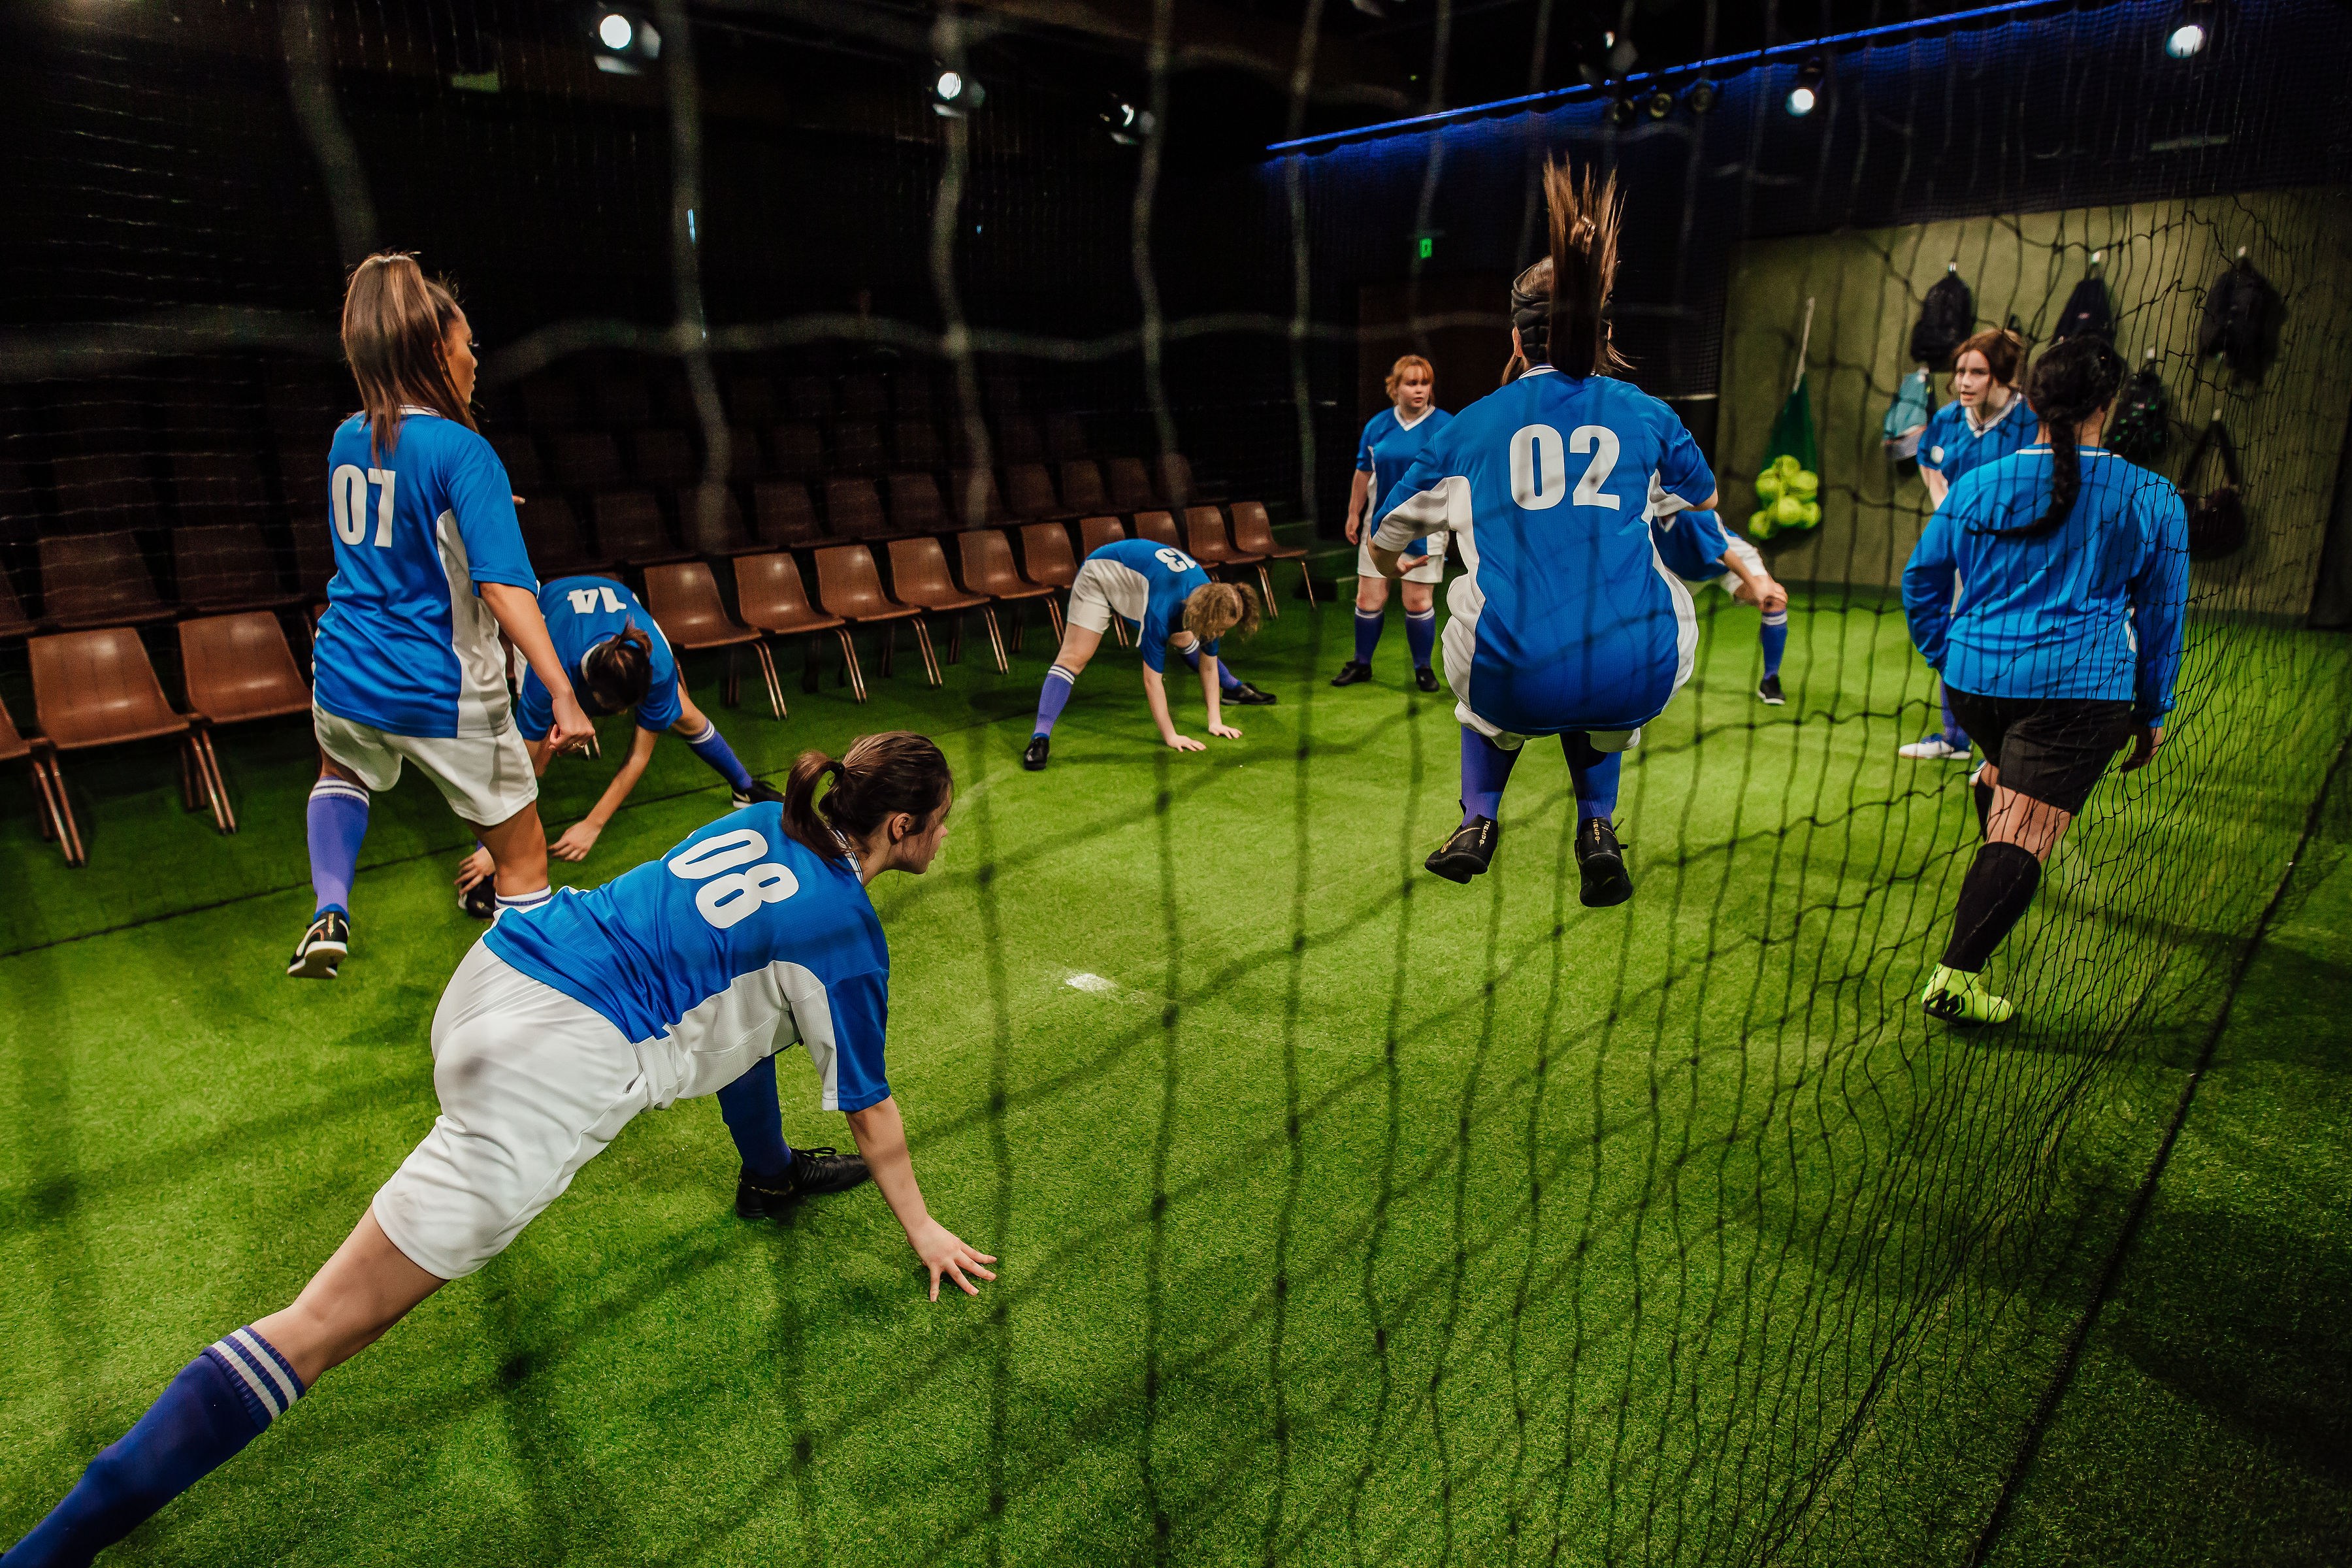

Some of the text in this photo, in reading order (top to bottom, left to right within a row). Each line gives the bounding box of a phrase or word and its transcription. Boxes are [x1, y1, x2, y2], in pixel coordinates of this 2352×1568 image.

[1509, 424, 1620, 510] 02
[332, 464, 396, 547] 07
[1154, 547, 1197, 572] 13
[567, 586, 627, 614] 14
[1479, 821, 1490, 847] TIEMPO
[668, 828, 799, 929] 08
